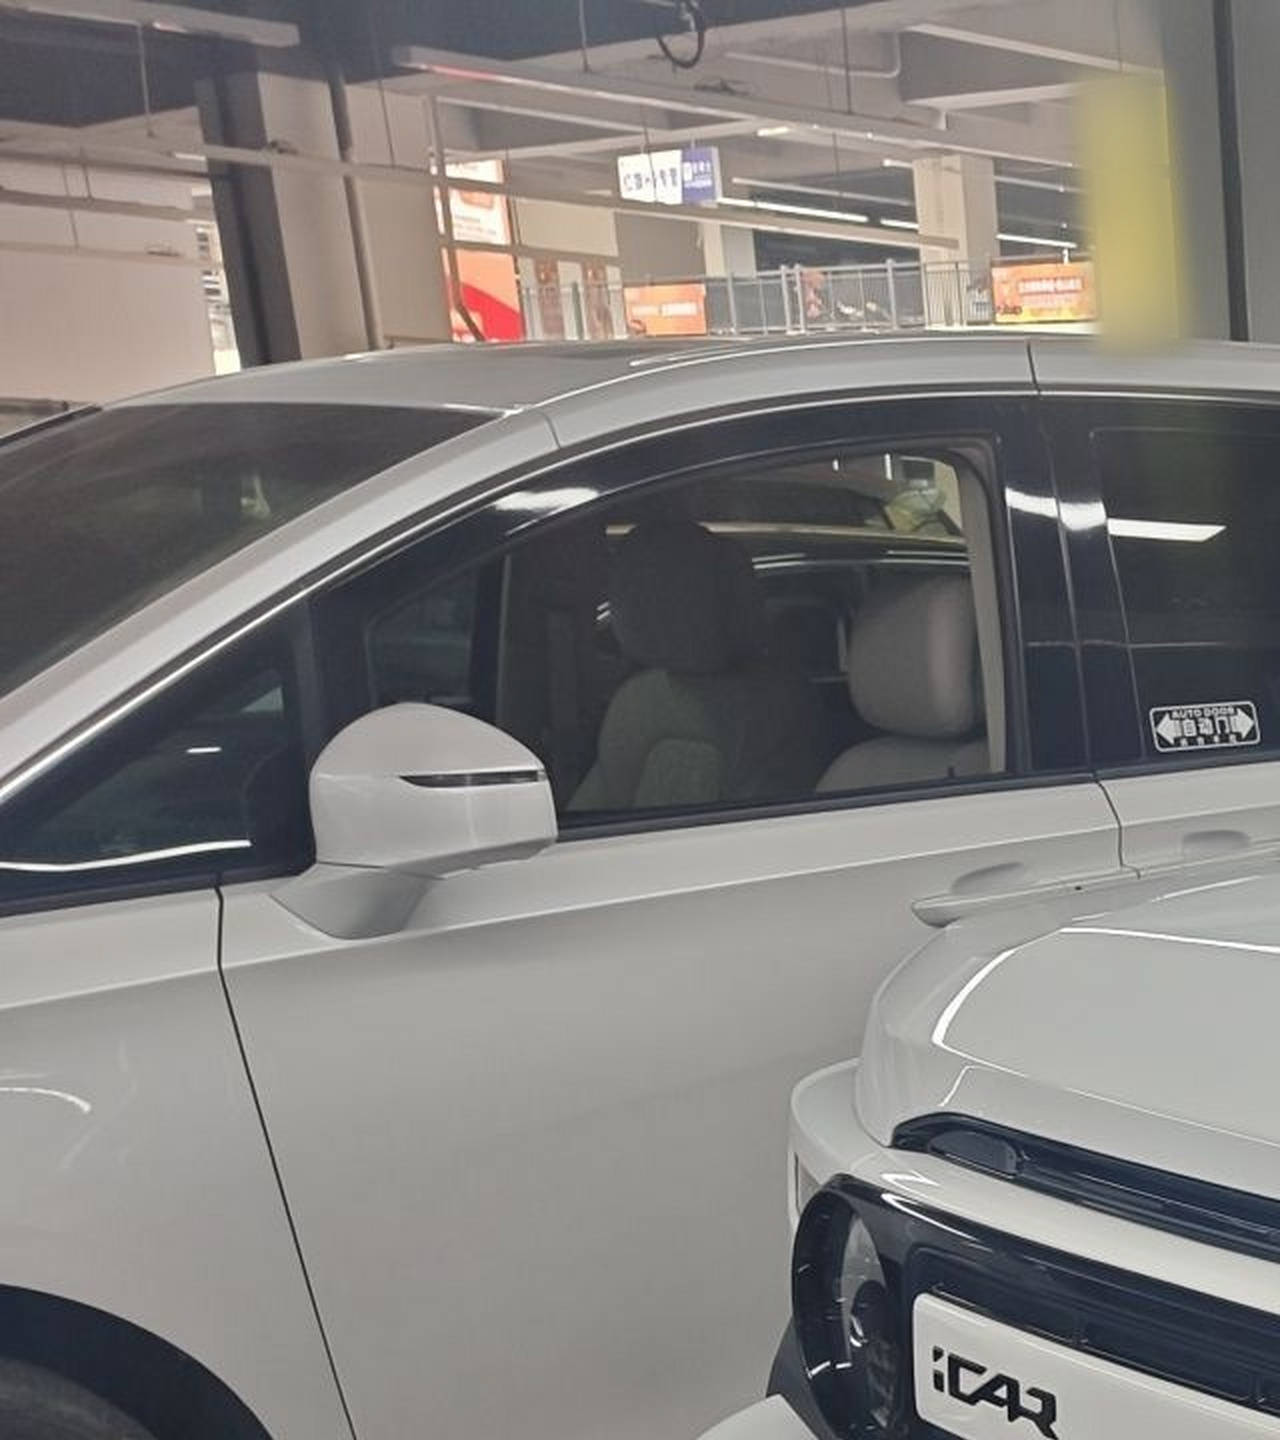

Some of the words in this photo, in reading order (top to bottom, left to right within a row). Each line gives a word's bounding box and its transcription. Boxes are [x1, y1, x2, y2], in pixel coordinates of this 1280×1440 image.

[1172, 709, 1202, 718] AUTO
[1204, 706, 1234, 717] DOOR
[1182, 716, 1230, 737] 自动门
[932, 1345, 1060, 1440] iCAR
